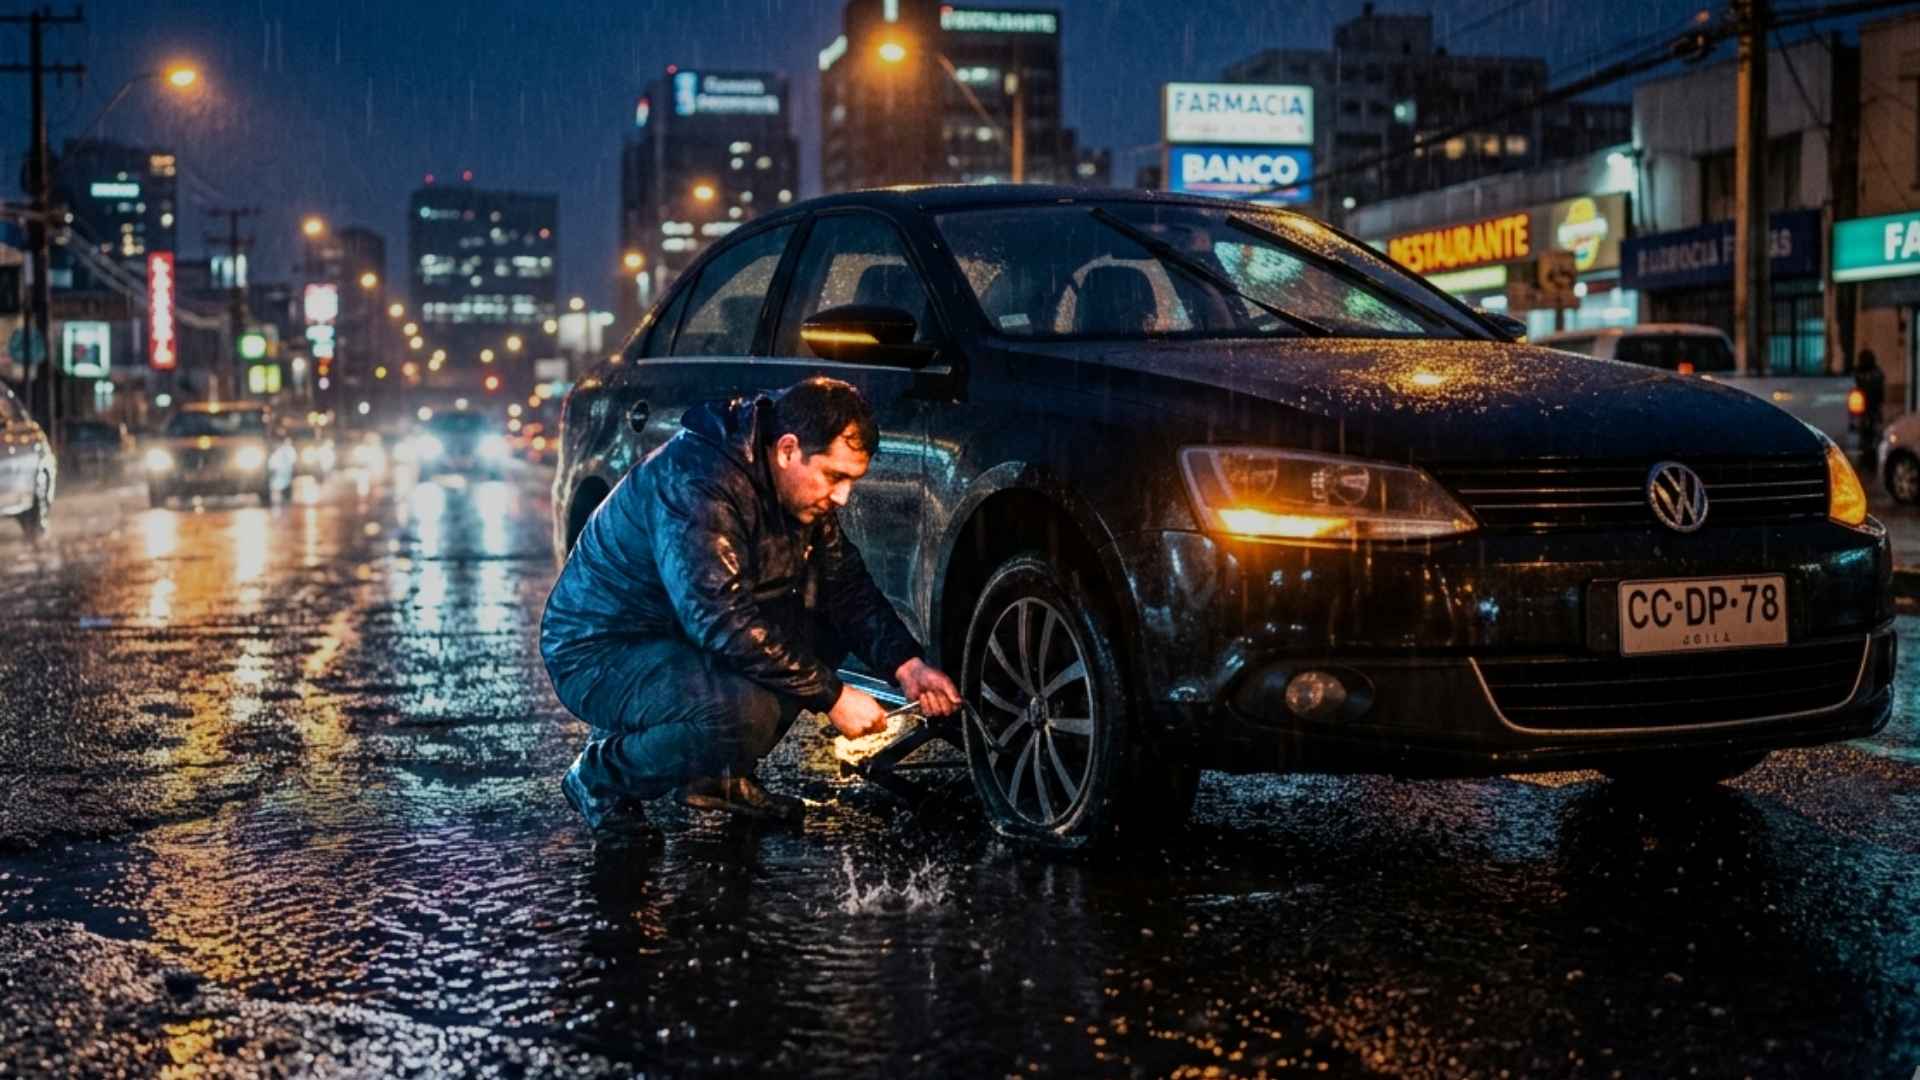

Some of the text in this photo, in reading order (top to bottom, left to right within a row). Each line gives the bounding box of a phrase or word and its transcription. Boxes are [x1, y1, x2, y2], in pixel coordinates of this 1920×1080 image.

[1175, 92, 1304, 116] FARMACIA
[1182, 153, 1299, 185] BANCO
[1885, 221, 1920, 260] FA
